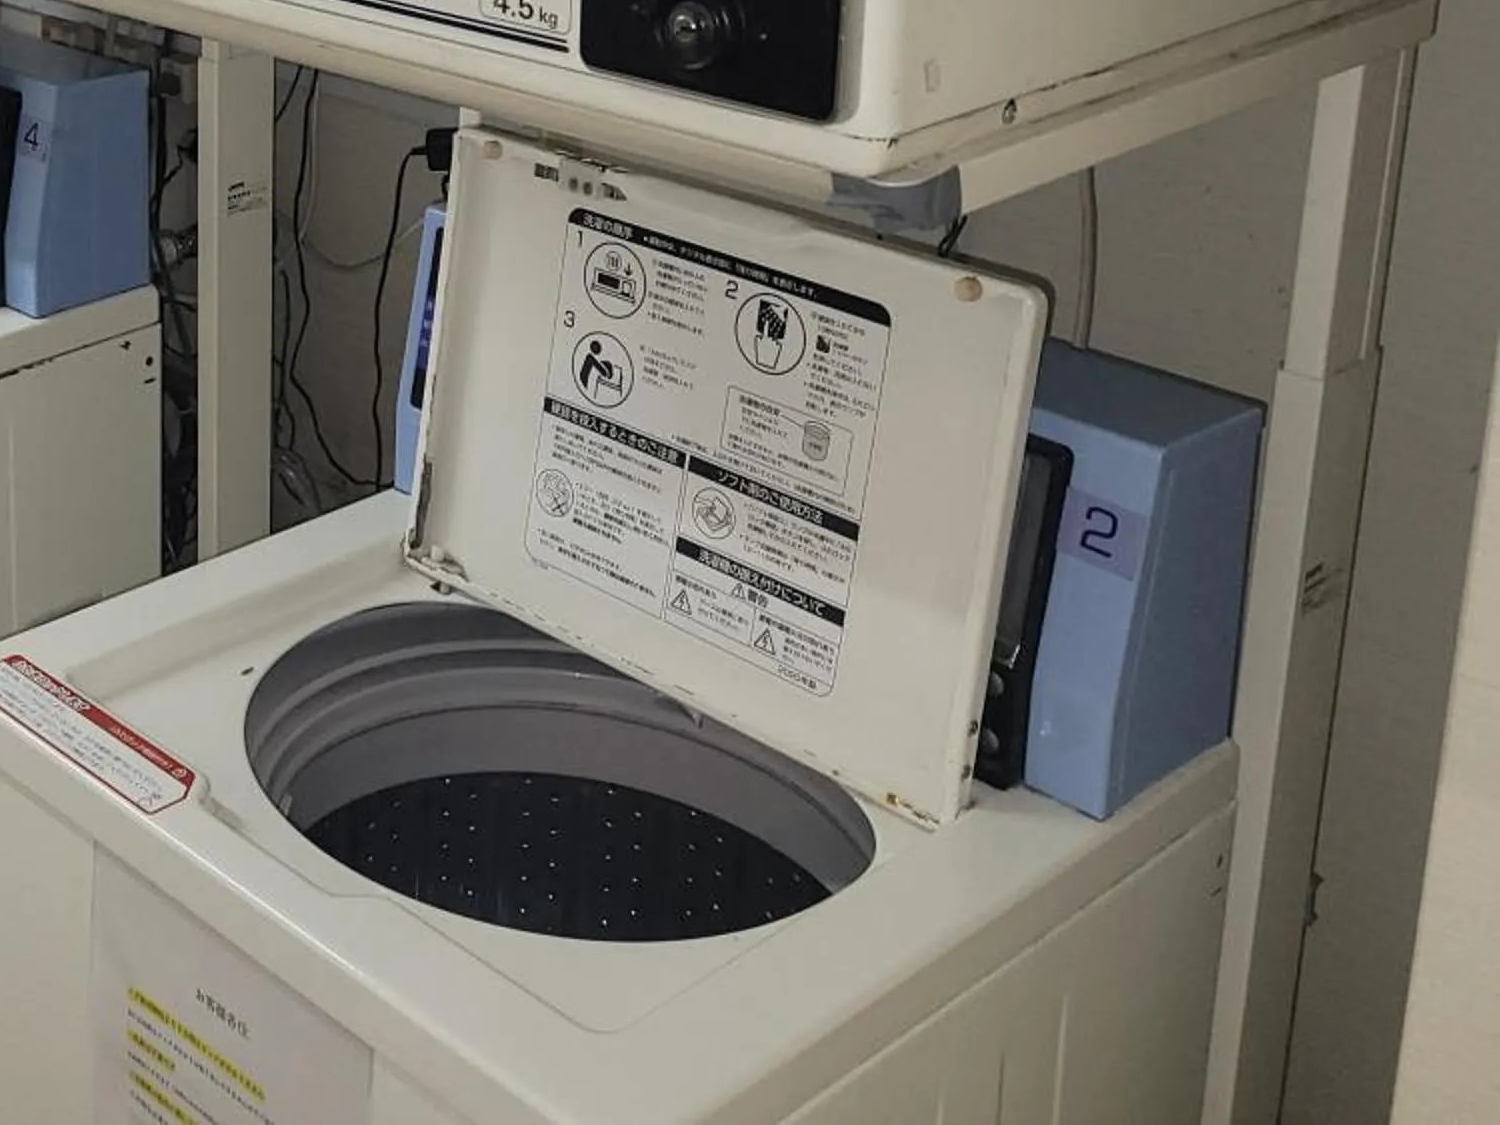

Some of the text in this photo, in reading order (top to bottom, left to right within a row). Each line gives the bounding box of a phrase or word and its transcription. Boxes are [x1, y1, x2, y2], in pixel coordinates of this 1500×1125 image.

[539, 7, 559, 30] kg
[23, 122, 40, 152] 4
[577, 230, 584, 247] 1
[725, 280, 739, 300] 2
[564, 310, 575, 328] 3
[1080, 506, 1118, 558] 2
